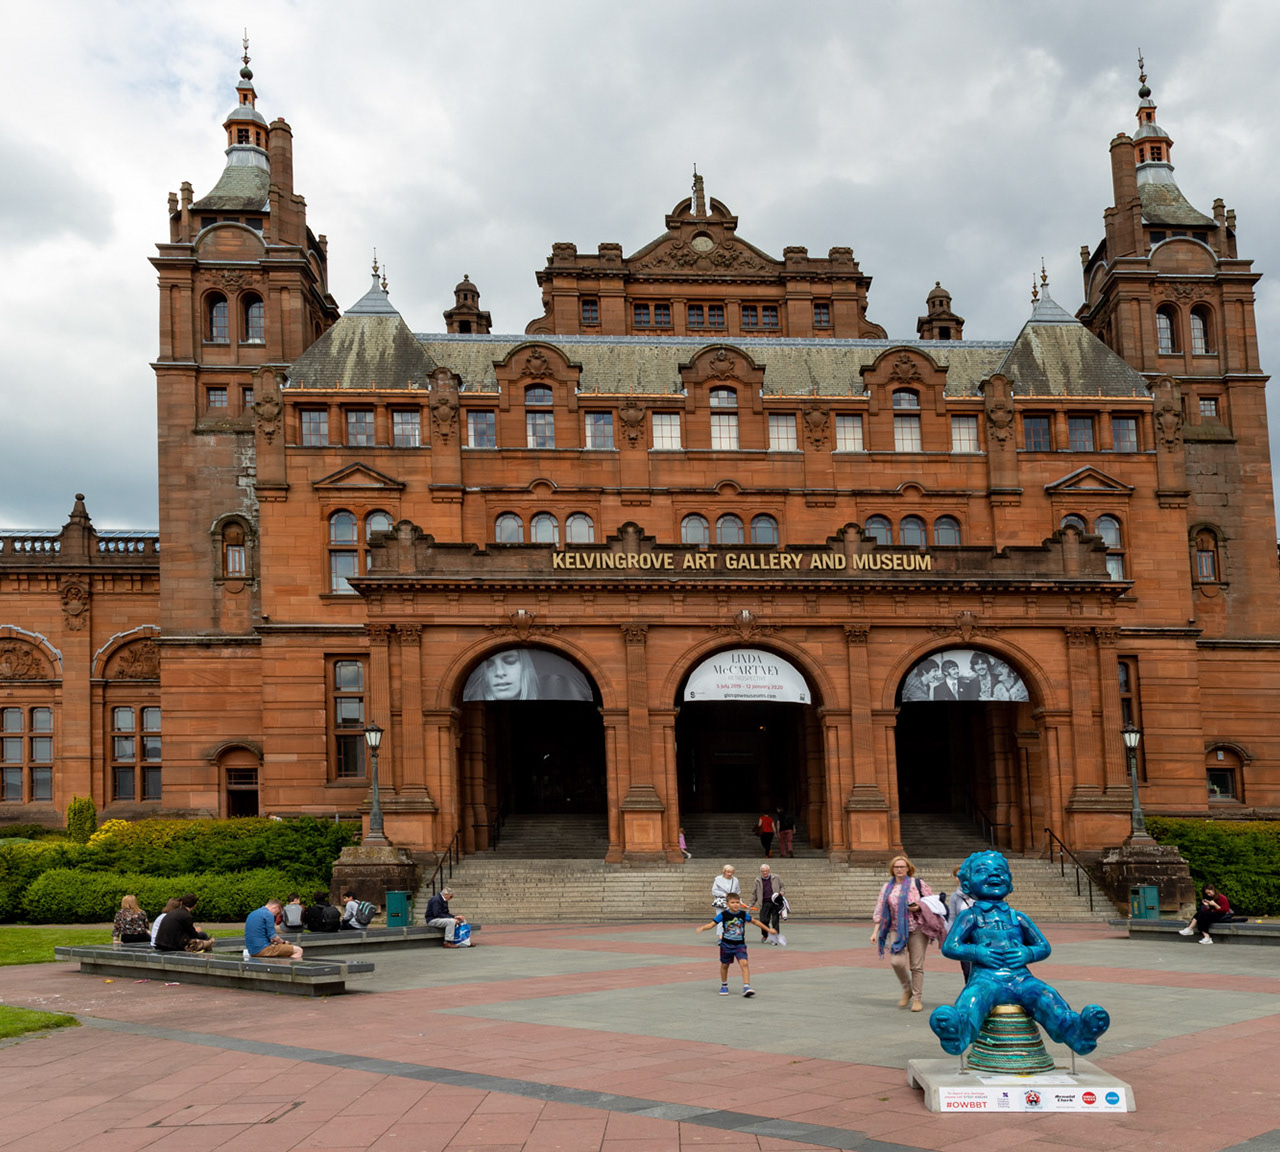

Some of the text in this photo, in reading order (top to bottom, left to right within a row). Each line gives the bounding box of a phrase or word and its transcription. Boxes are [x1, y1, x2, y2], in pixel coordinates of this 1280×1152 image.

[552, 552, 932, 571] KELVINGROVE ART GALLERY AND MUSEUM
[731, 653, 762, 664] LINDA
[713, 665, 779, 675] McCARTNEY
